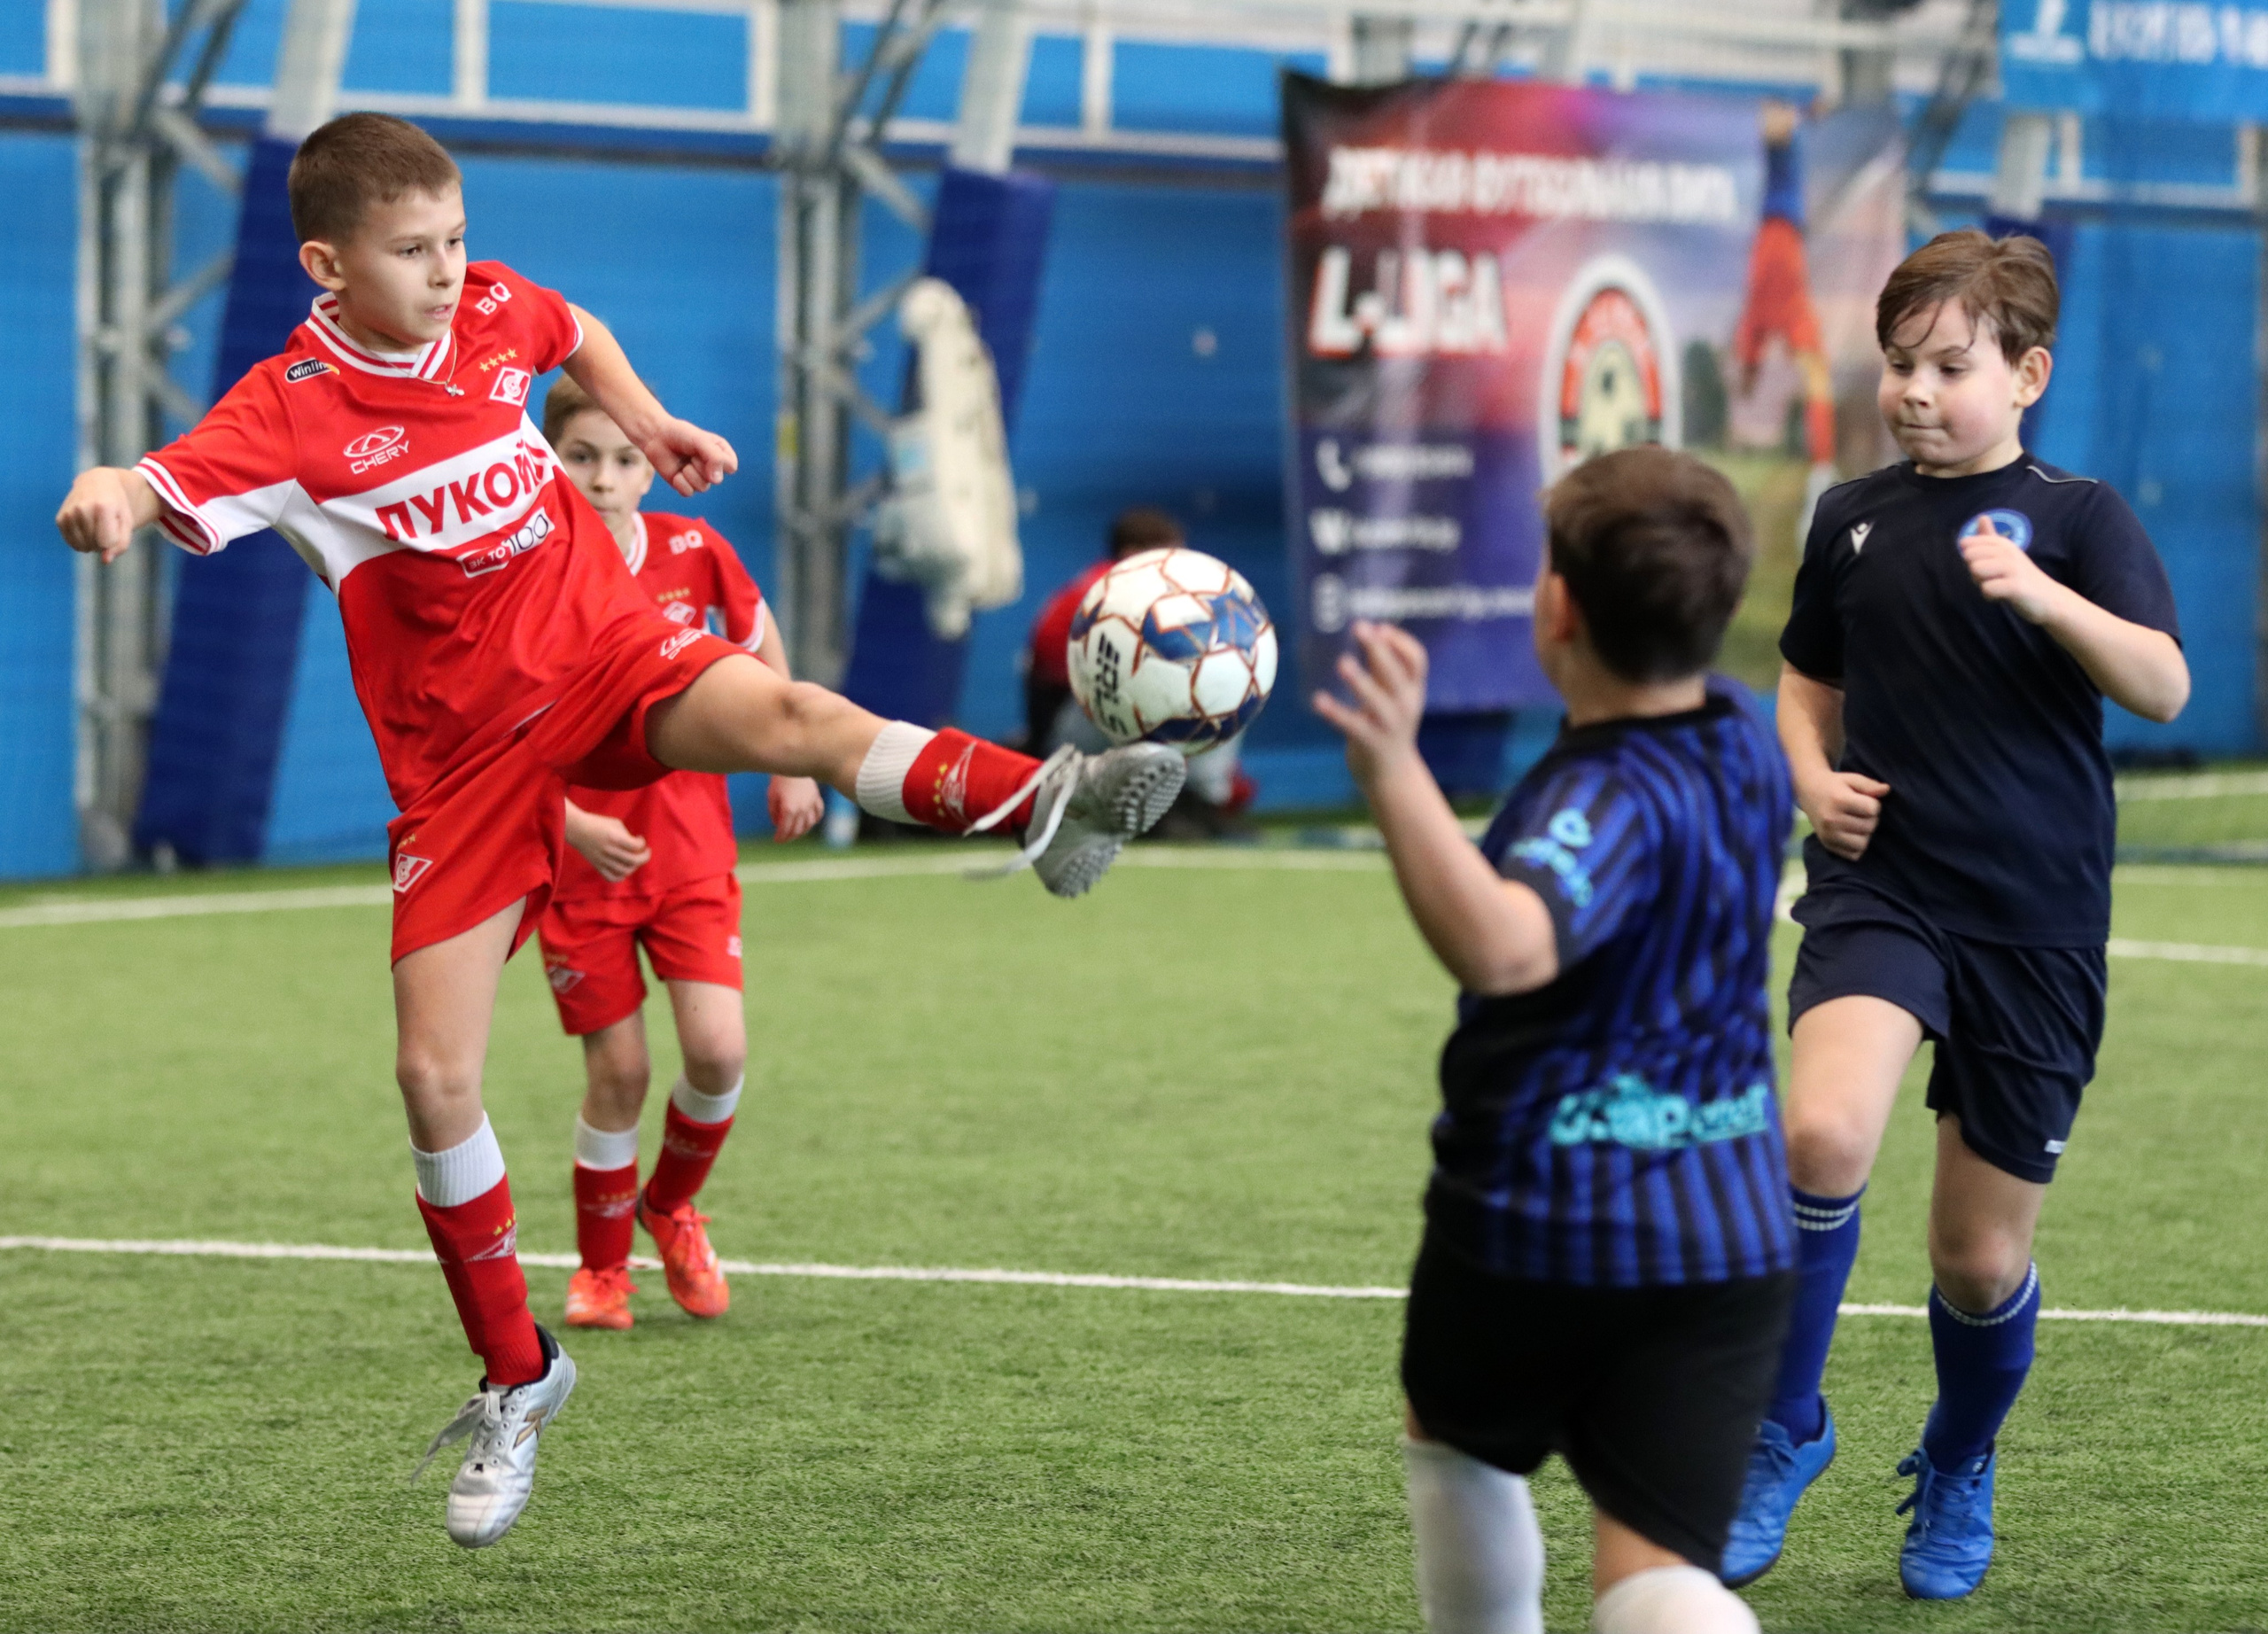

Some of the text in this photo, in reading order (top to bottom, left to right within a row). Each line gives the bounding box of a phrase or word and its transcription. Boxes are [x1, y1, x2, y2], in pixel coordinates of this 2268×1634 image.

[475, 282, 512, 315] BQ
[290, 361, 328, 378] Winlin
[350, 440, 409, 475] CHERY
[503, 514, 548, 553] 100
[669, 529, 704, 556] BQ
